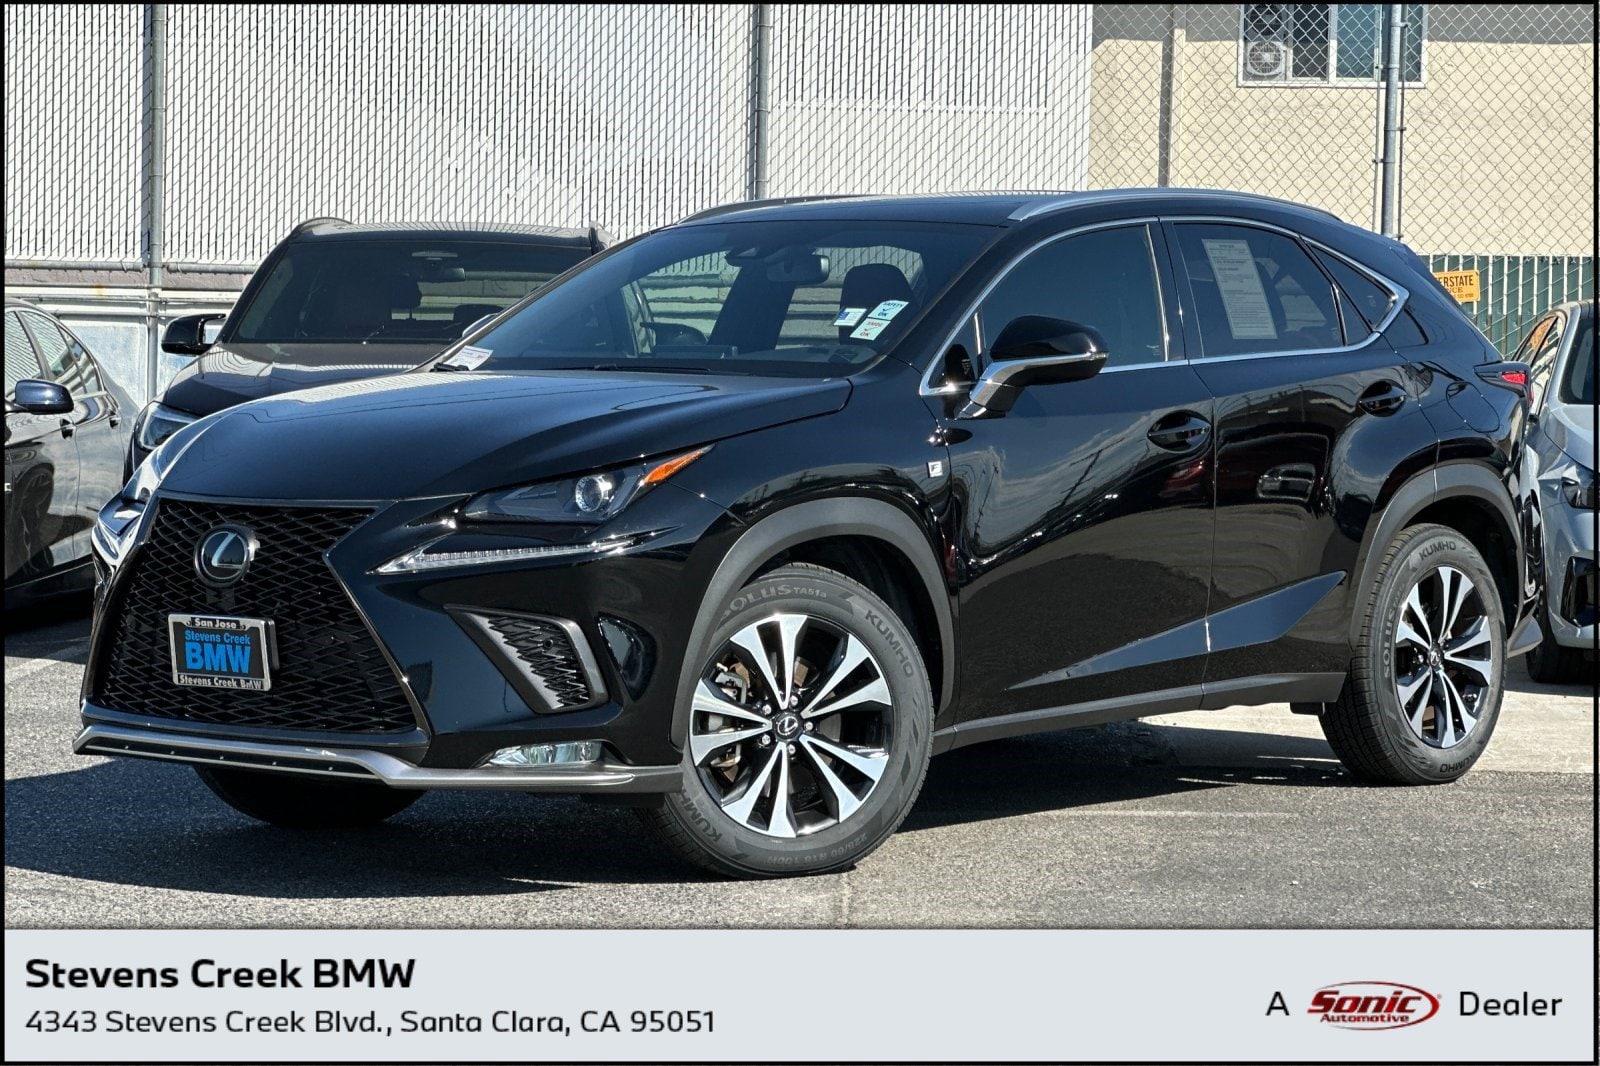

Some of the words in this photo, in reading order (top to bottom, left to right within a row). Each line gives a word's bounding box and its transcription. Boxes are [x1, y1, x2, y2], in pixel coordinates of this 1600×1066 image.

[1418, 540, 1457, 560] KUMHO
[194, 618, 214, 628] San
[215, 618, 237, 629] Jose
[184, 630, 221, 642] Stevens
[223, 632, 251, 645] Creek
[864, 610, 915, 678] KUMHO
[1383, 608, 1396, 679] SOLUS
[185, 641, 251, 673] BMW
[179, 675, 212, 686] Stevens
[213, 677, 238, 688] Creek
